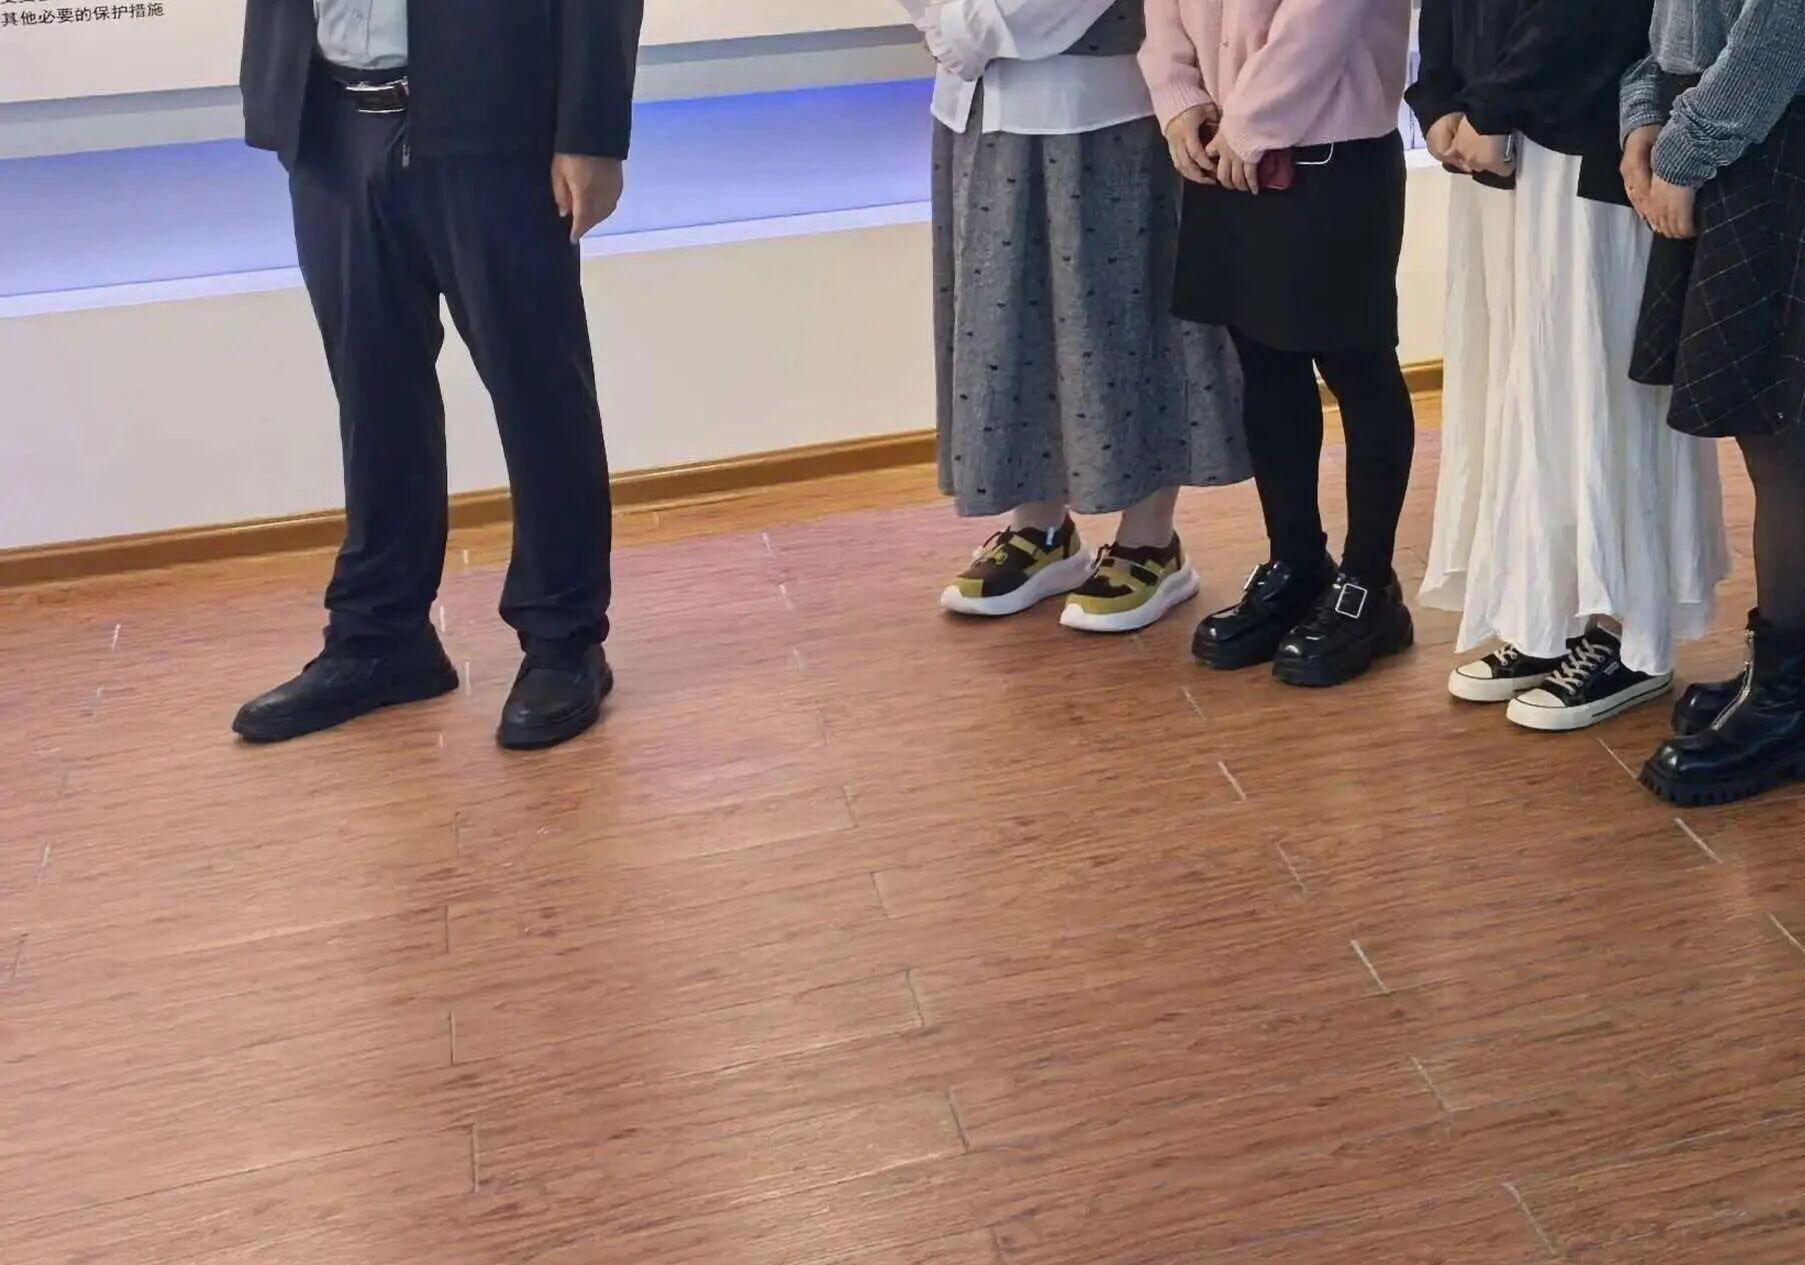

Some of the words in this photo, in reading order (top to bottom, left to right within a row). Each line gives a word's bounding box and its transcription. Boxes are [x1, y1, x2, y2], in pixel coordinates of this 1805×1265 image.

[2, 1, 164, 28] 其他必要的保护措施
